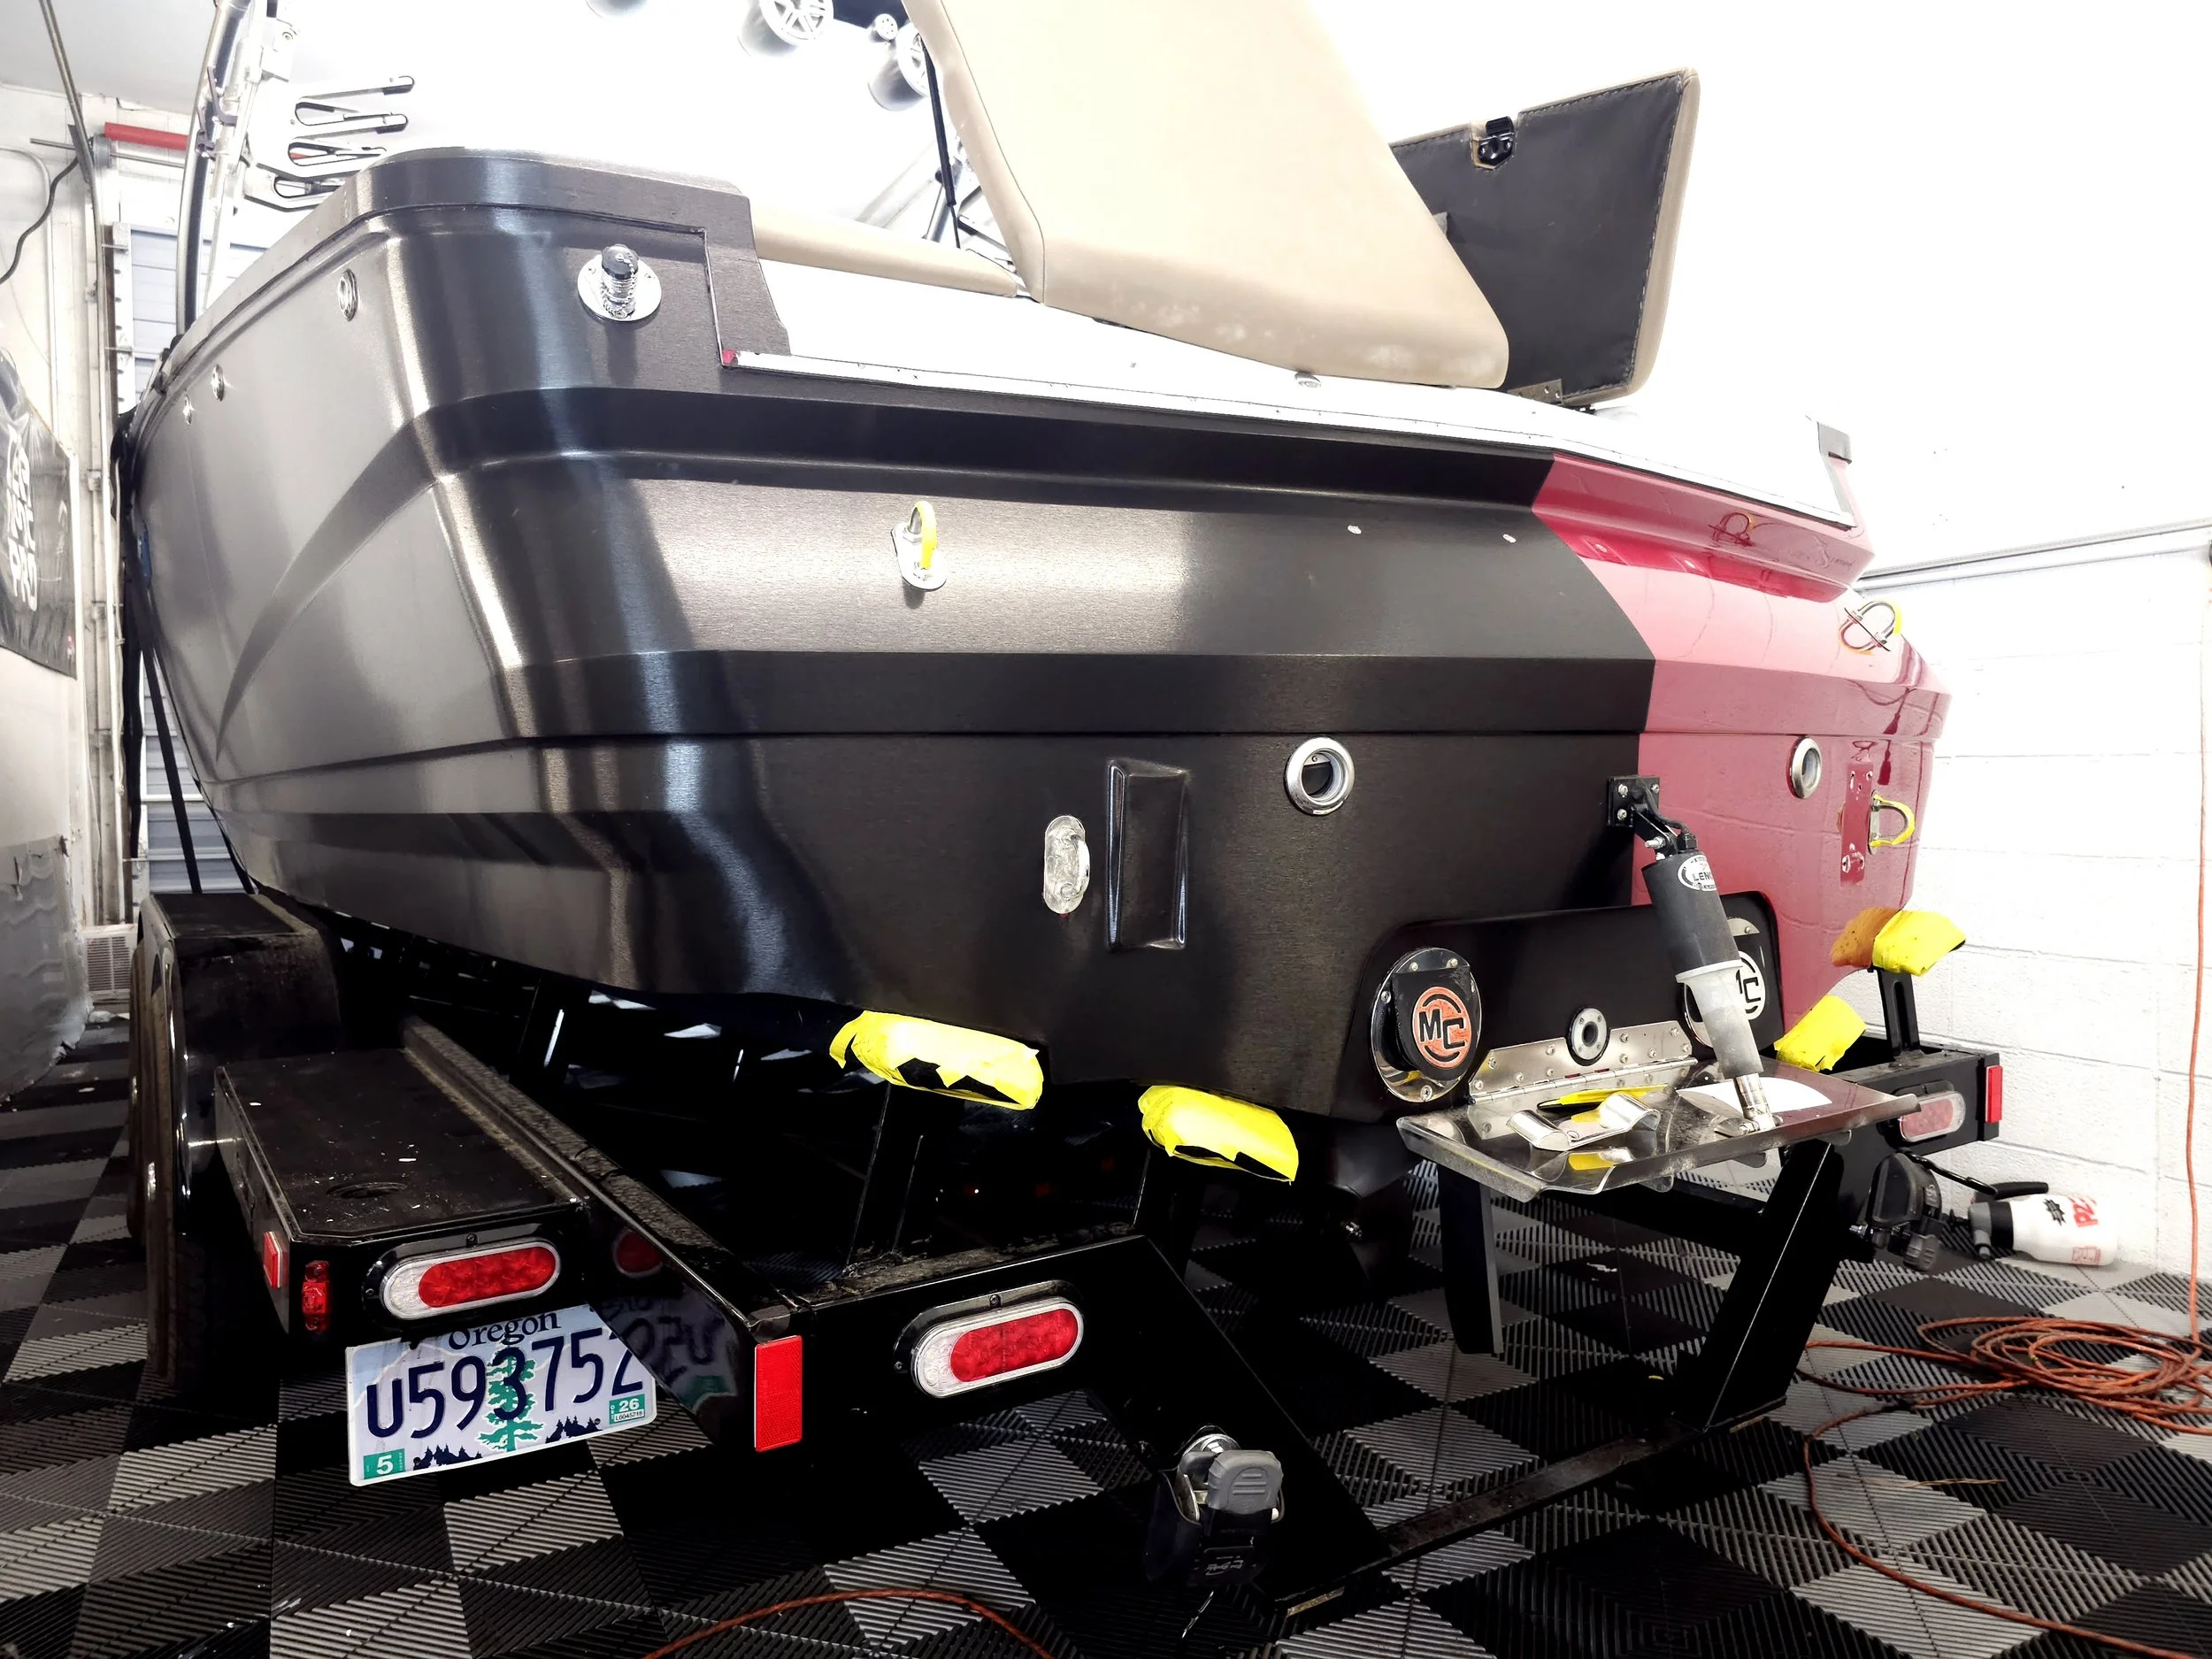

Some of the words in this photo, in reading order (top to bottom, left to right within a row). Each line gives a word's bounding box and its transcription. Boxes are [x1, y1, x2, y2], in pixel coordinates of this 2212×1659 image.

[1418, 1009, 1465, 1049] MC
[449, 1312, 561, 1349] Oregon
[366, 1327, 644, 1439] U593752
[618, 1398, 640, 1413] 26
[376, 1455, 394, 1475] 5
